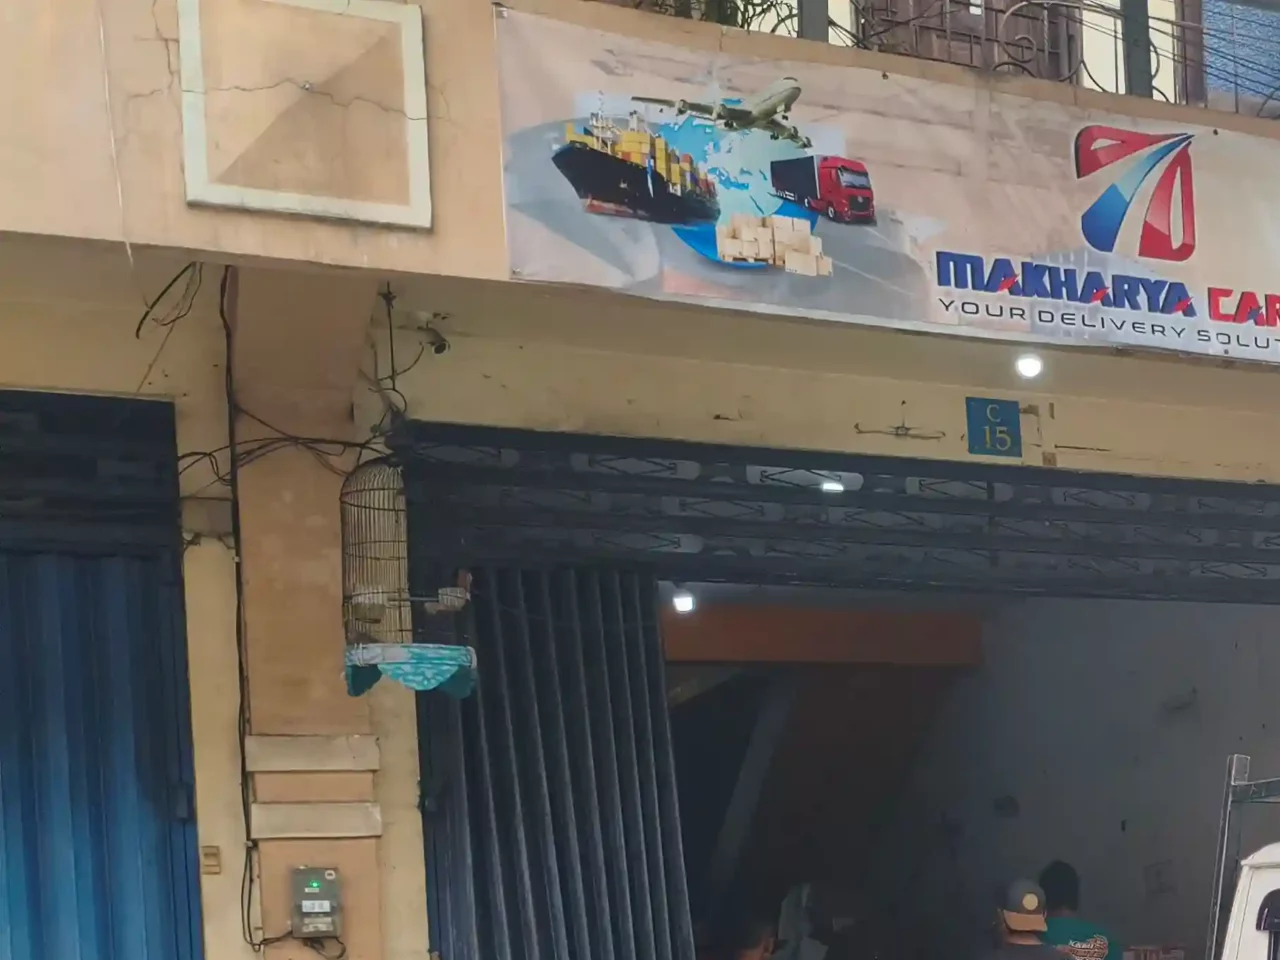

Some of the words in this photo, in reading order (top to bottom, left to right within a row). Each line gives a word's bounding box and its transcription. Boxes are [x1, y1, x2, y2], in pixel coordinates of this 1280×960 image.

[936, 250, 1197, 317] MAKHARYA
[938, 297, 1026, 323] YOUR
[1037, 308, 1187, 338] DELIVERY
[986, 404, 1001, 422] C
[983, 426, 1012, 451] 15
